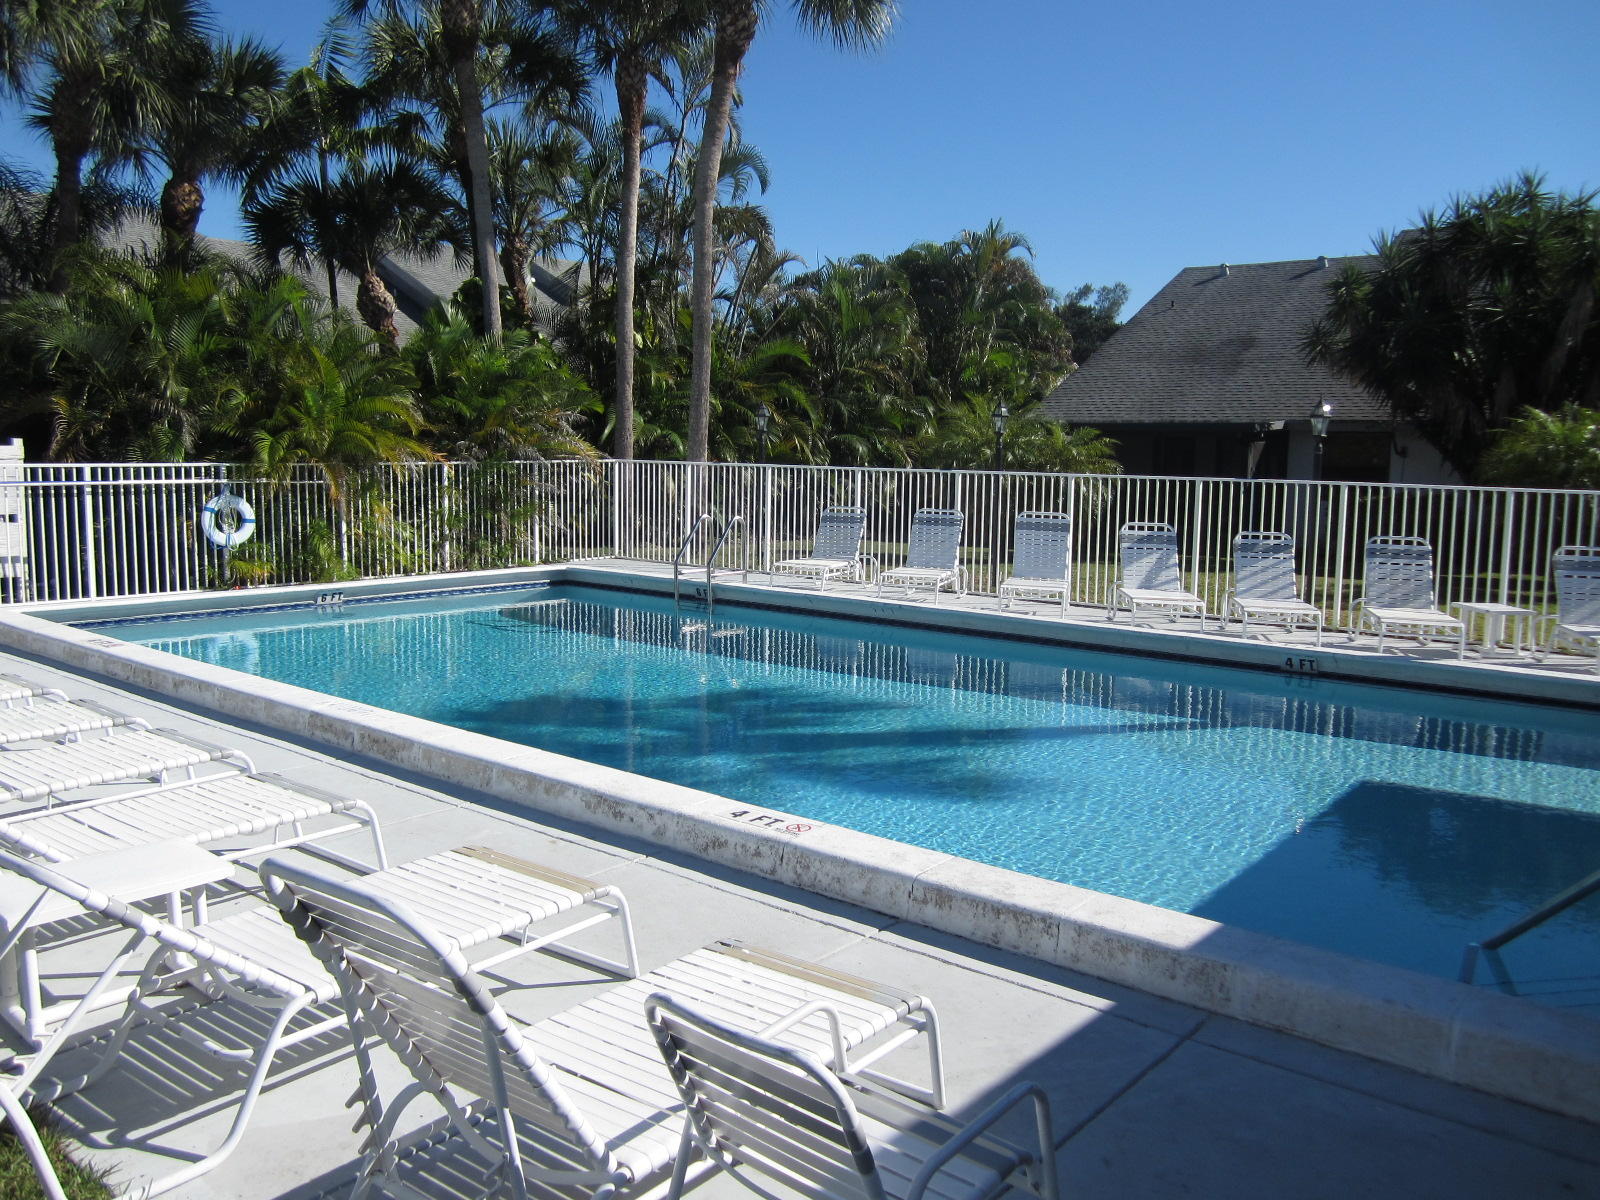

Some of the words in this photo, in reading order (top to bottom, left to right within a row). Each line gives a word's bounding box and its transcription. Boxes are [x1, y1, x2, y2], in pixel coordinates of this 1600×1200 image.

[321, 593, 328, 602] 6
[330, 592, 344, 601] FT
[1285, 657, 1293, 669] 4
[1299, 658, 1315, 671] FT
[730, 810, 750, 818] 4
[749, 815, 785, 826] FT
